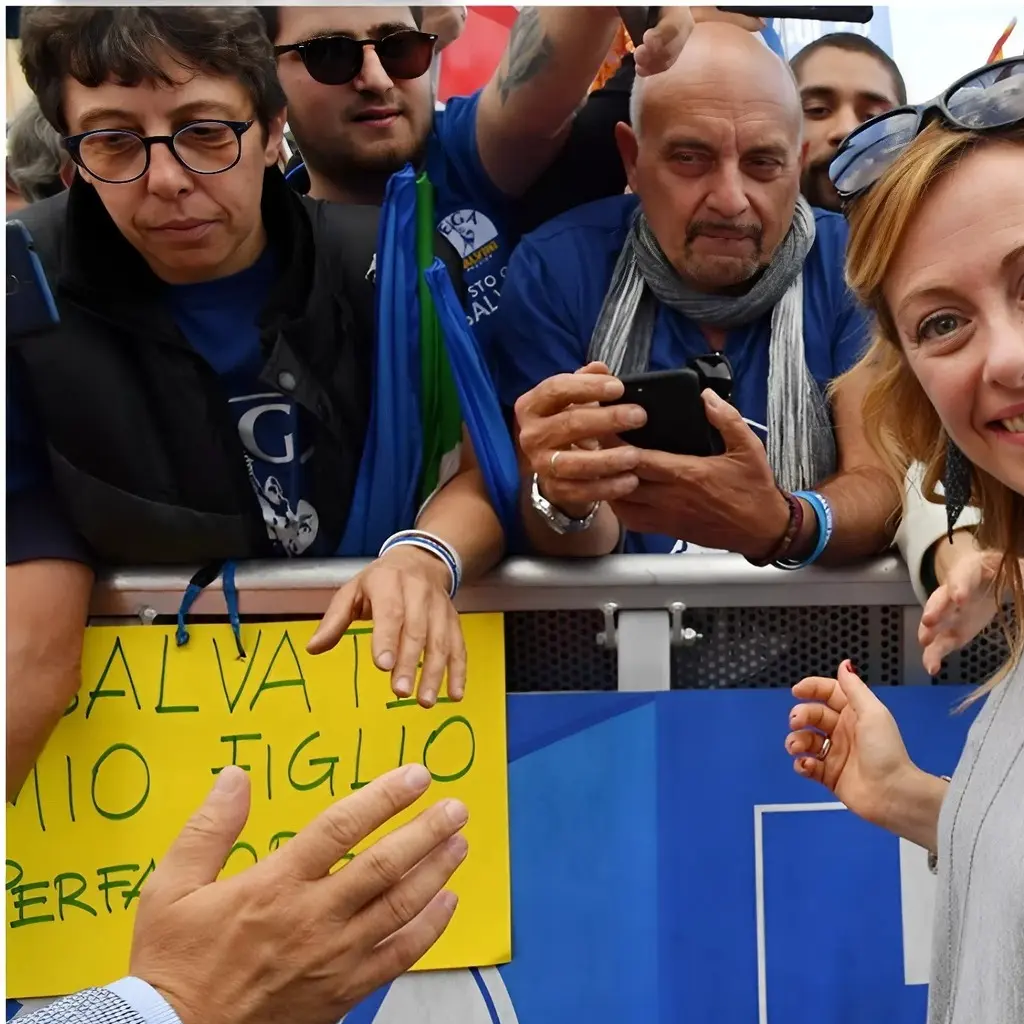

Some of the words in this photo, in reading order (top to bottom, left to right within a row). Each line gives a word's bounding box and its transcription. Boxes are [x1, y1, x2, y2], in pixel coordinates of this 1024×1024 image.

[466, 289, 501, 325] AL
[237, 403, 315, 464] G
[64, 627, 464, 719] ALVAT
